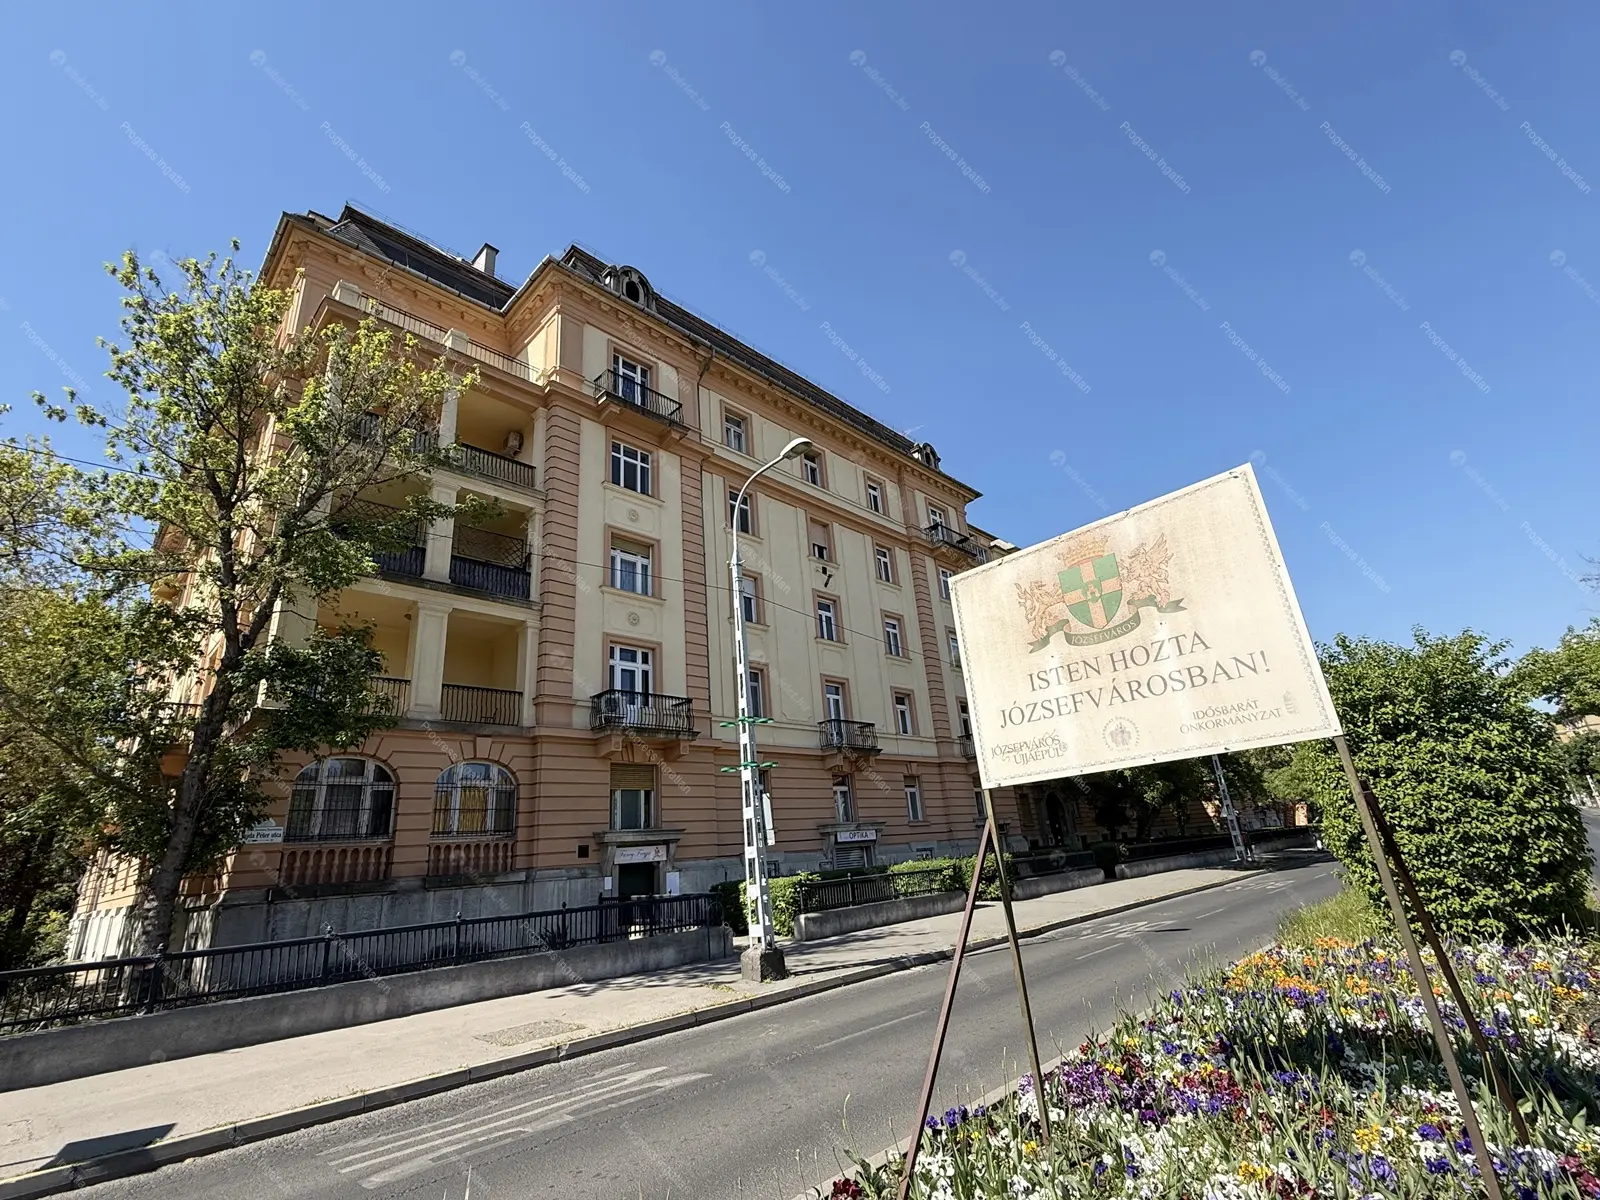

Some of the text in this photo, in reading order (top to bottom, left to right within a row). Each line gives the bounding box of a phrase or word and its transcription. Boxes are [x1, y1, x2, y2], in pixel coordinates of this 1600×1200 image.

[1027, 630, 1212, 692] ISTEN HOZTA
[1000, 650, 1271, 728] JÓZSEFVÁROSBAN!
[1179, 707, 1282, 734] ÖNKORMÁNYZAT
[849, 831, 869, 840] OPTIKA
